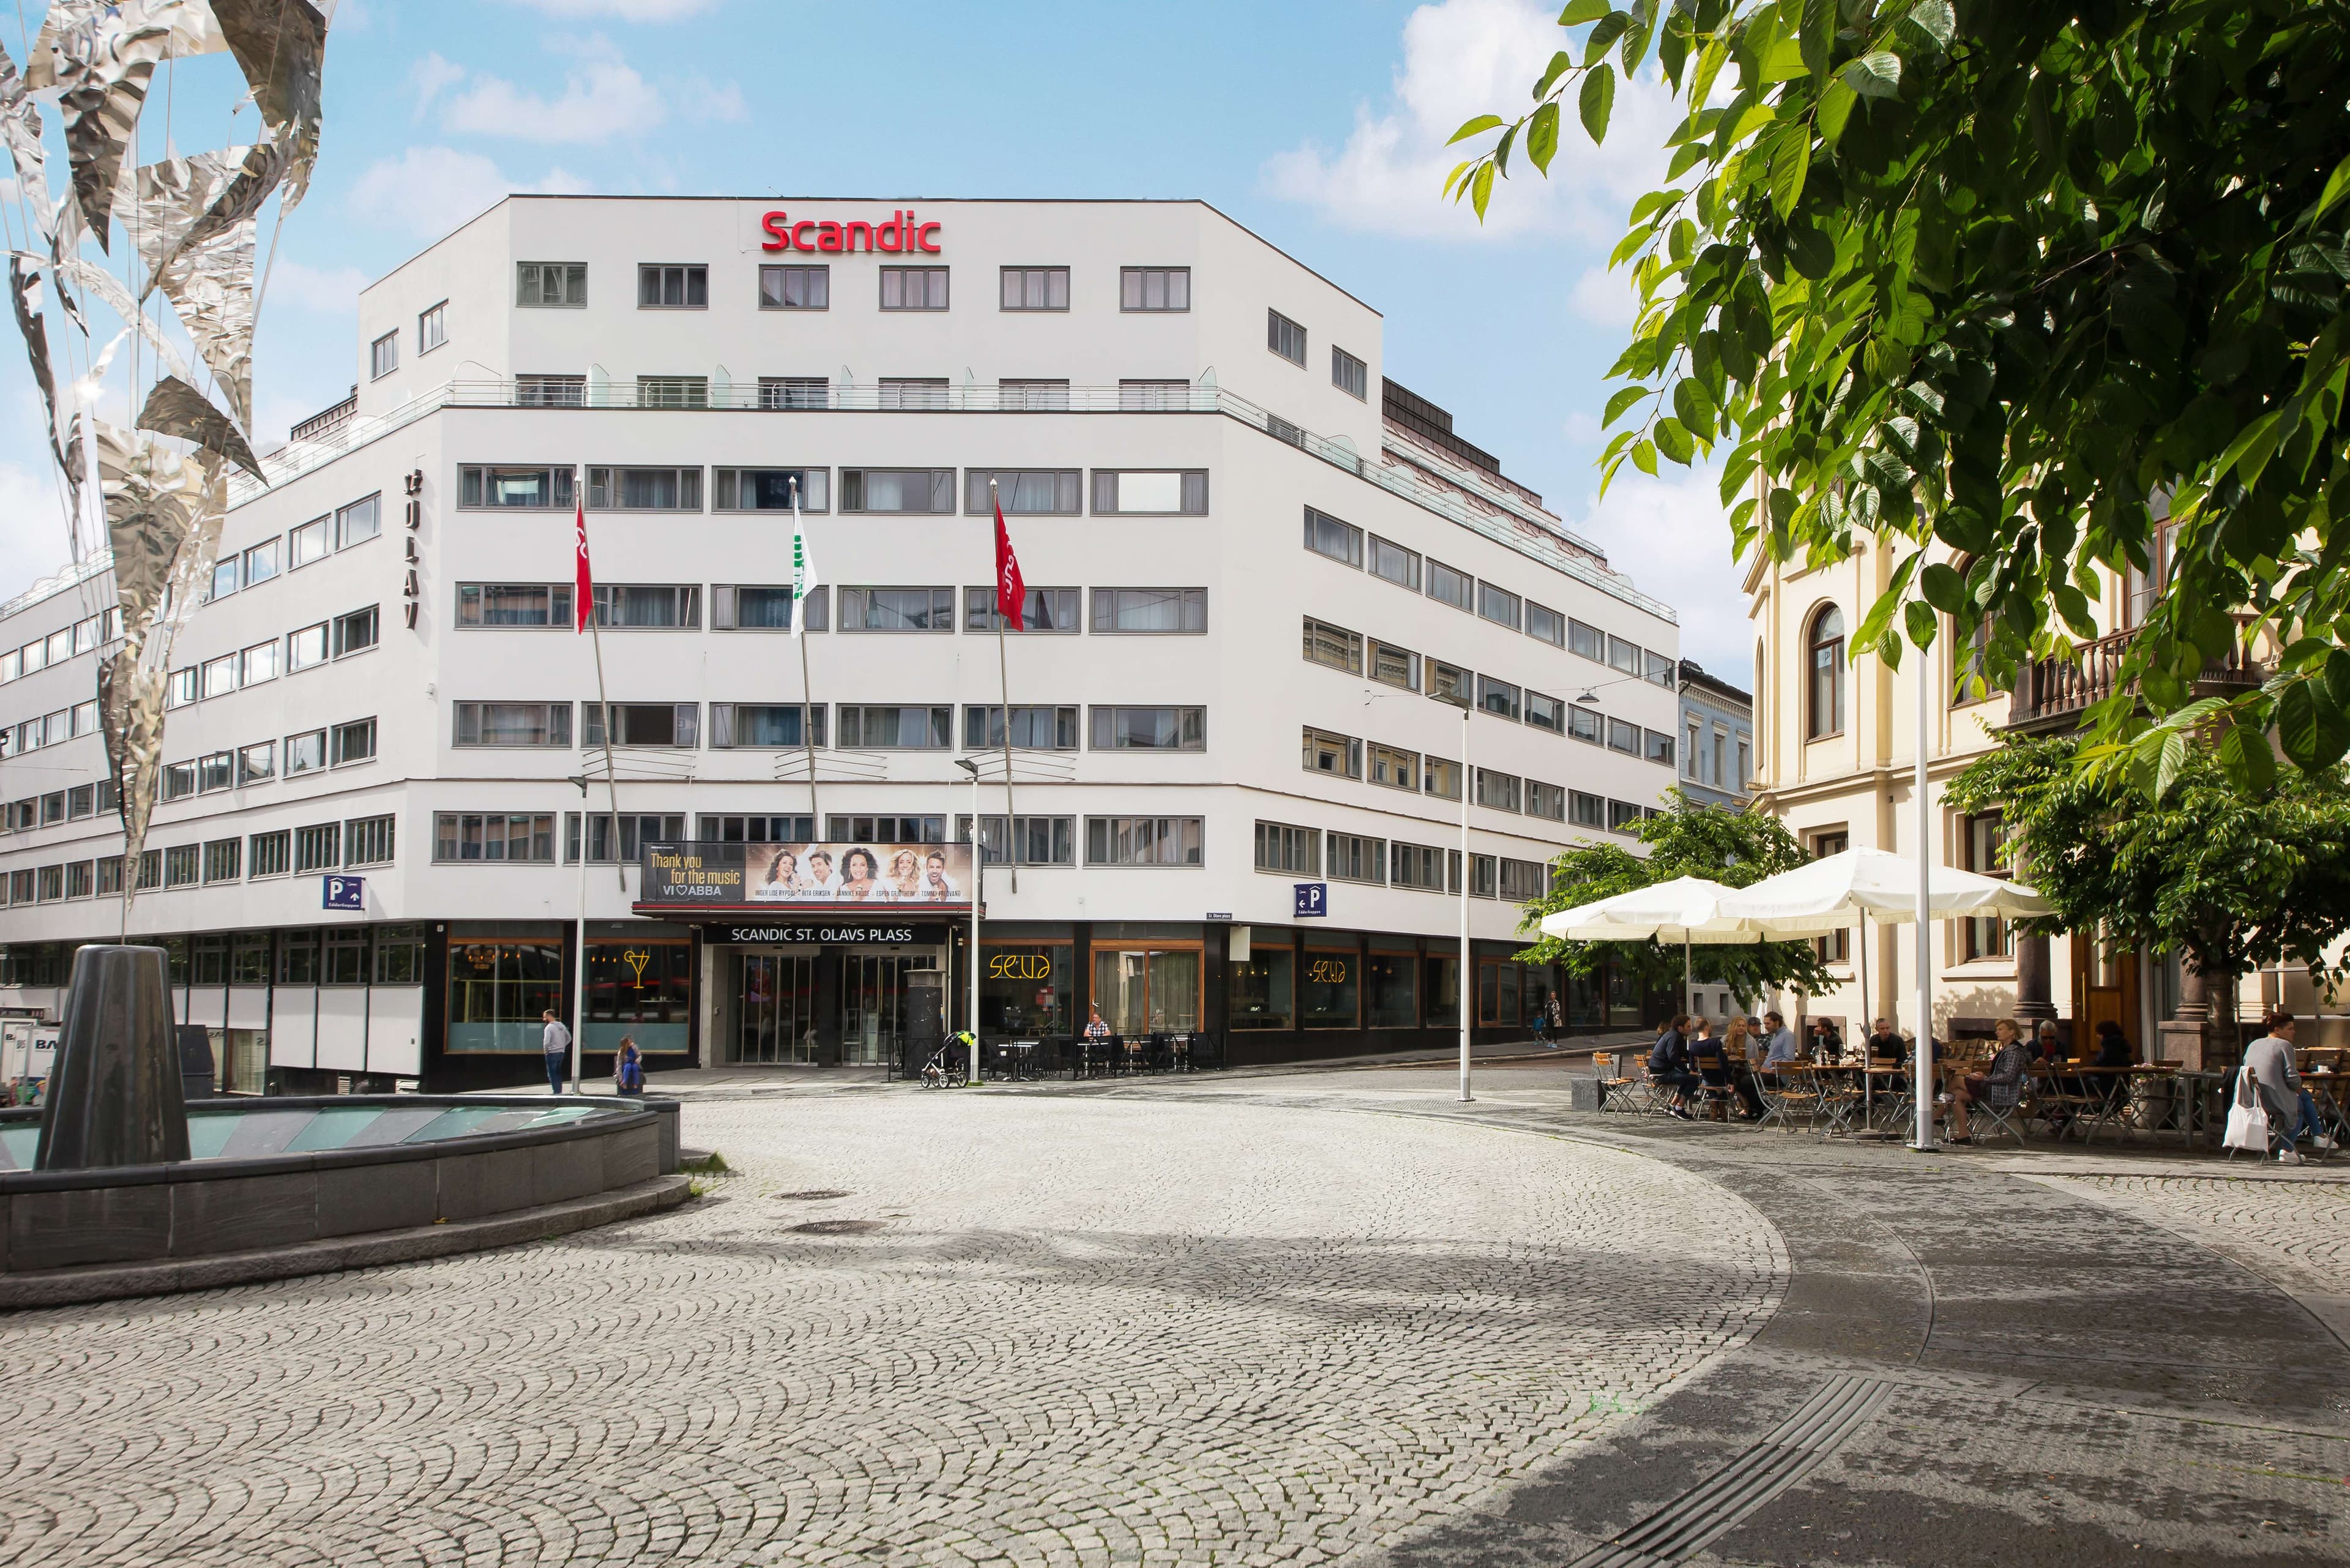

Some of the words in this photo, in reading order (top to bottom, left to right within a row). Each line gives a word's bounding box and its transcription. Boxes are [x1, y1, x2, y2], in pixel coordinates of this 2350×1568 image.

[761, 210, 941, 252] Scandic
[651, 853, 681, 868] Thank
[684, 856, 701, 870] you
[671, 868, 687, 884] for
[688, 868, 705, 884] the
[707, 870, 740, 885] music
[330, 881, 343, 900] P
[663, 886, 674, 895] VI
[688, 886, 722, 895] ABBA
[1311, 889, 1320, 908] P
[732, 928, 793, 941] SCANDIC
[796, 928, 815, 941] ST.
[820, 928, 865, 941] OLAVS
[870, 929, 912, 941] PLASS
